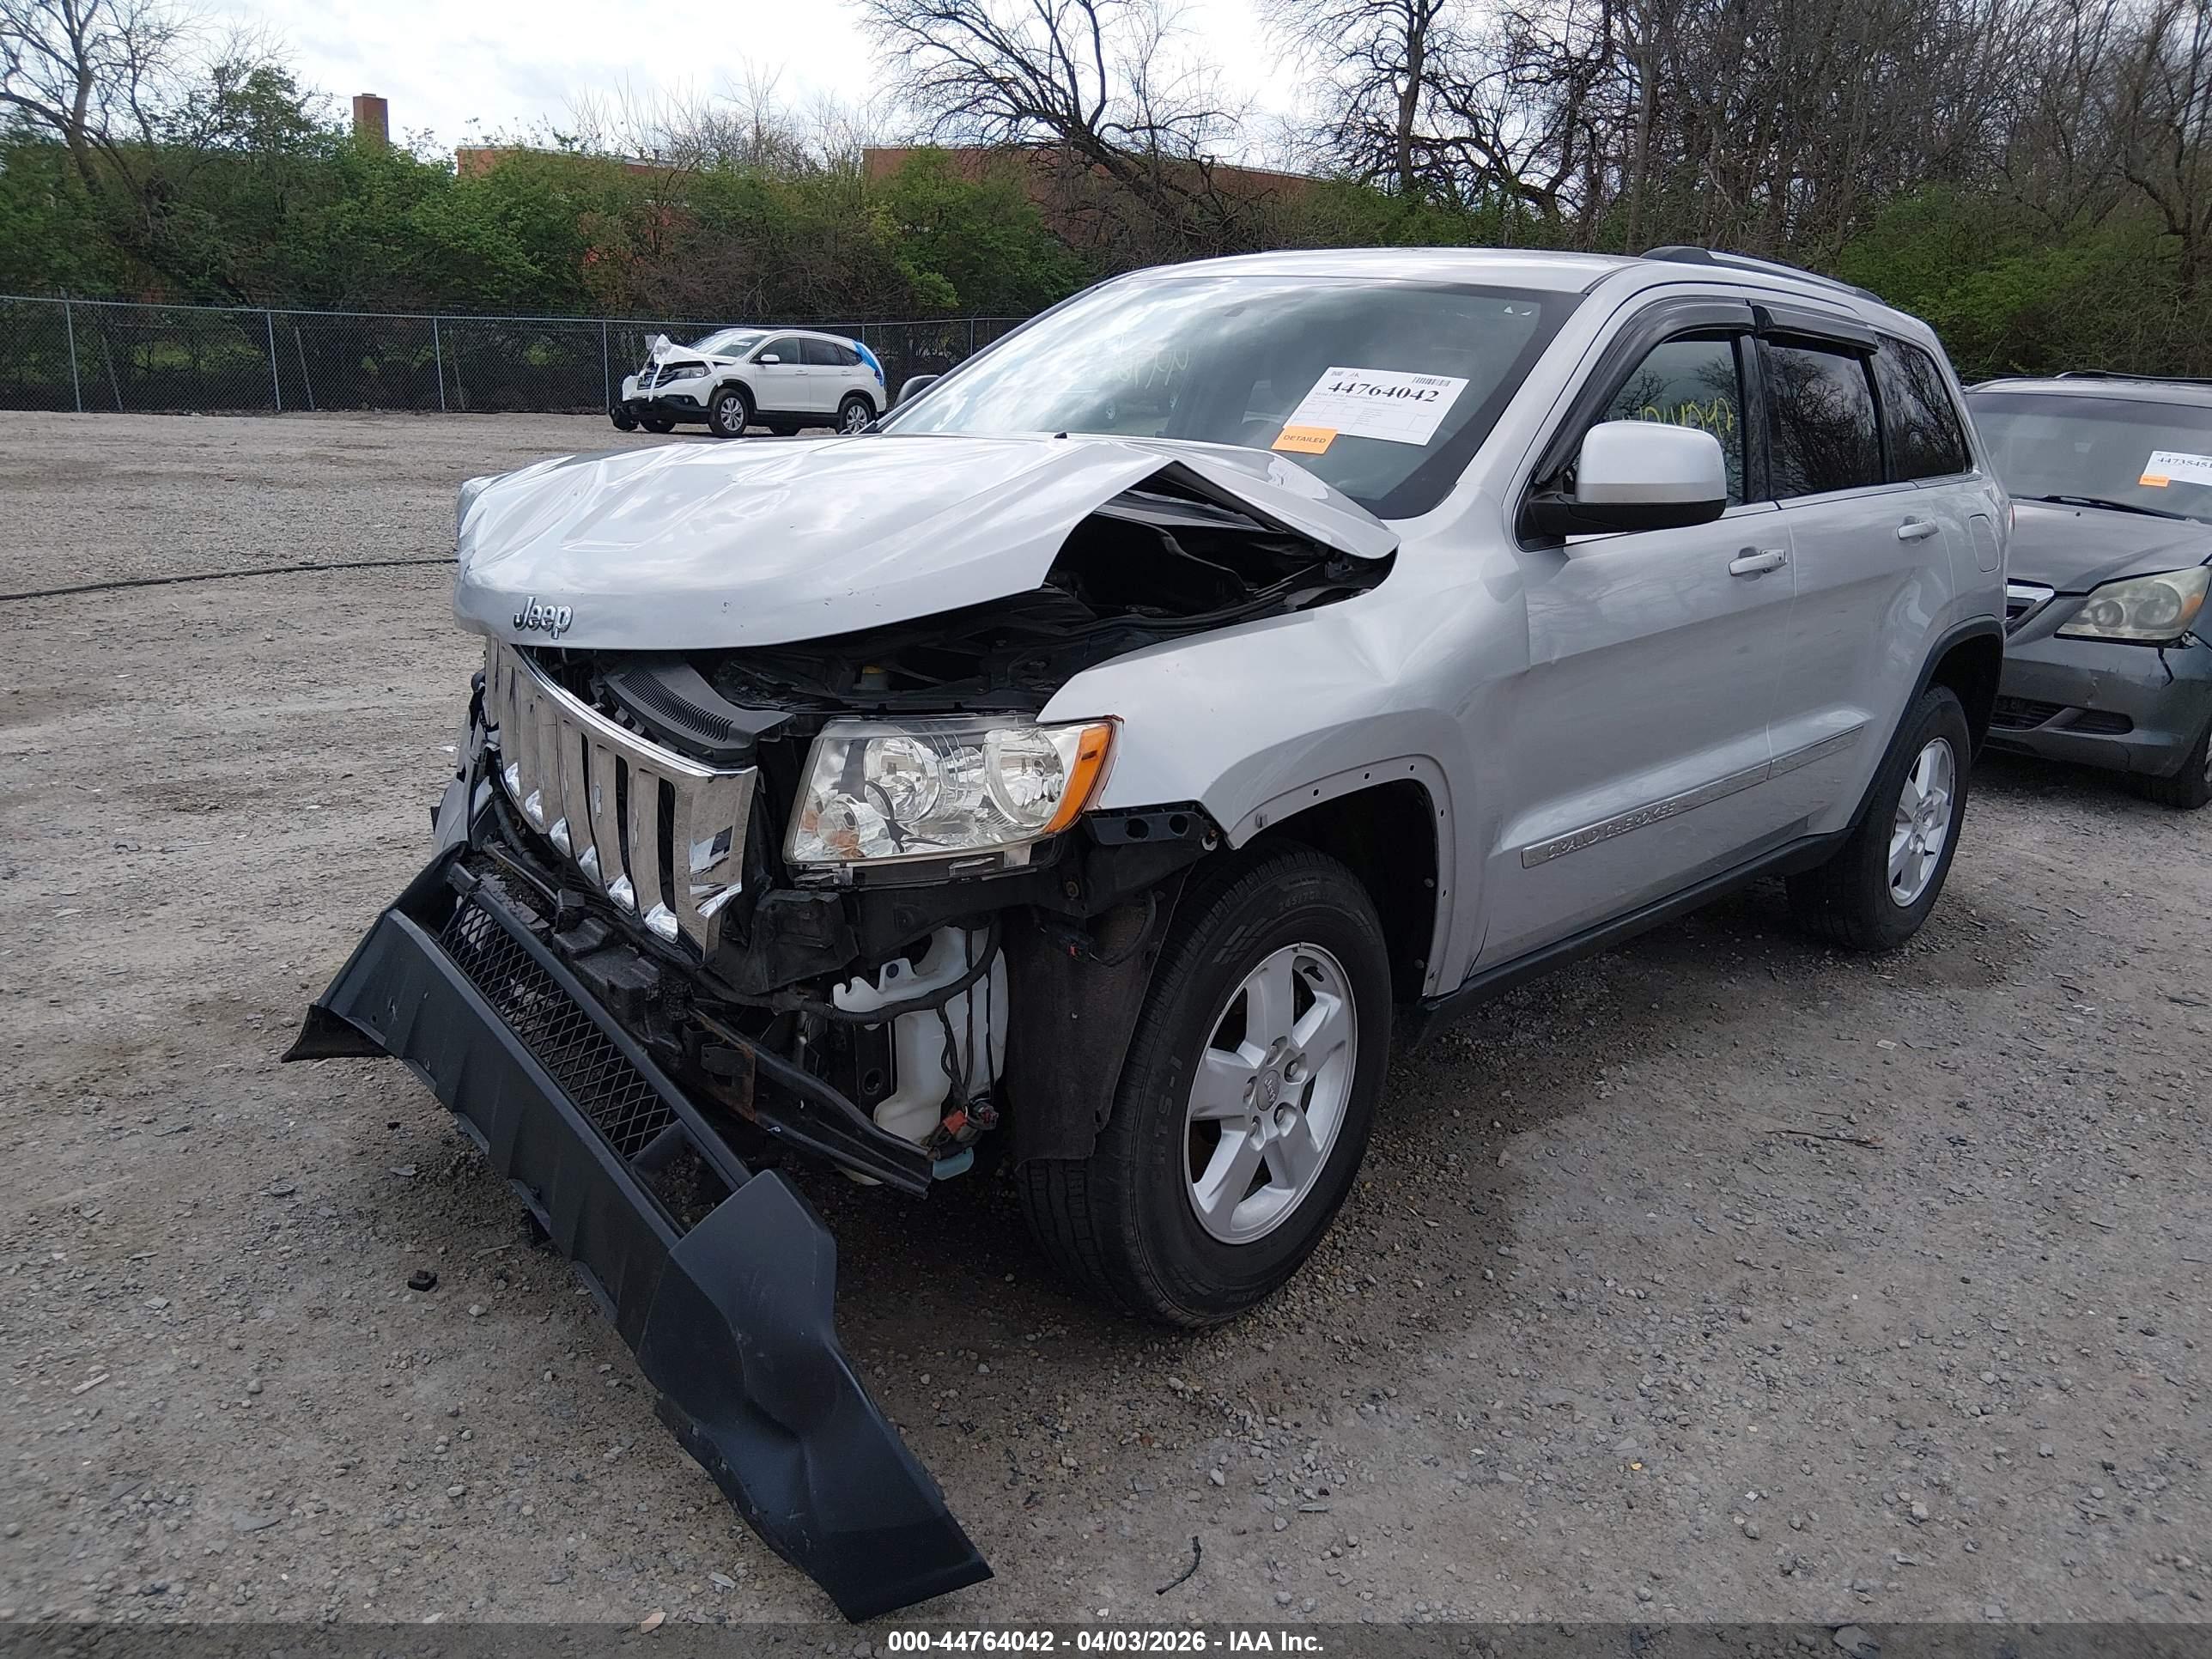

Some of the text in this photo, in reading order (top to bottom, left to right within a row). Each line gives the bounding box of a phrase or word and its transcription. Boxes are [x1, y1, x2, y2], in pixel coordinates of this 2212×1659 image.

[1328, 380, 1440, 403] 44764042
[1283, 434, 1327, 445] DETAILED
[514, 596, 574, 640] Jeep
